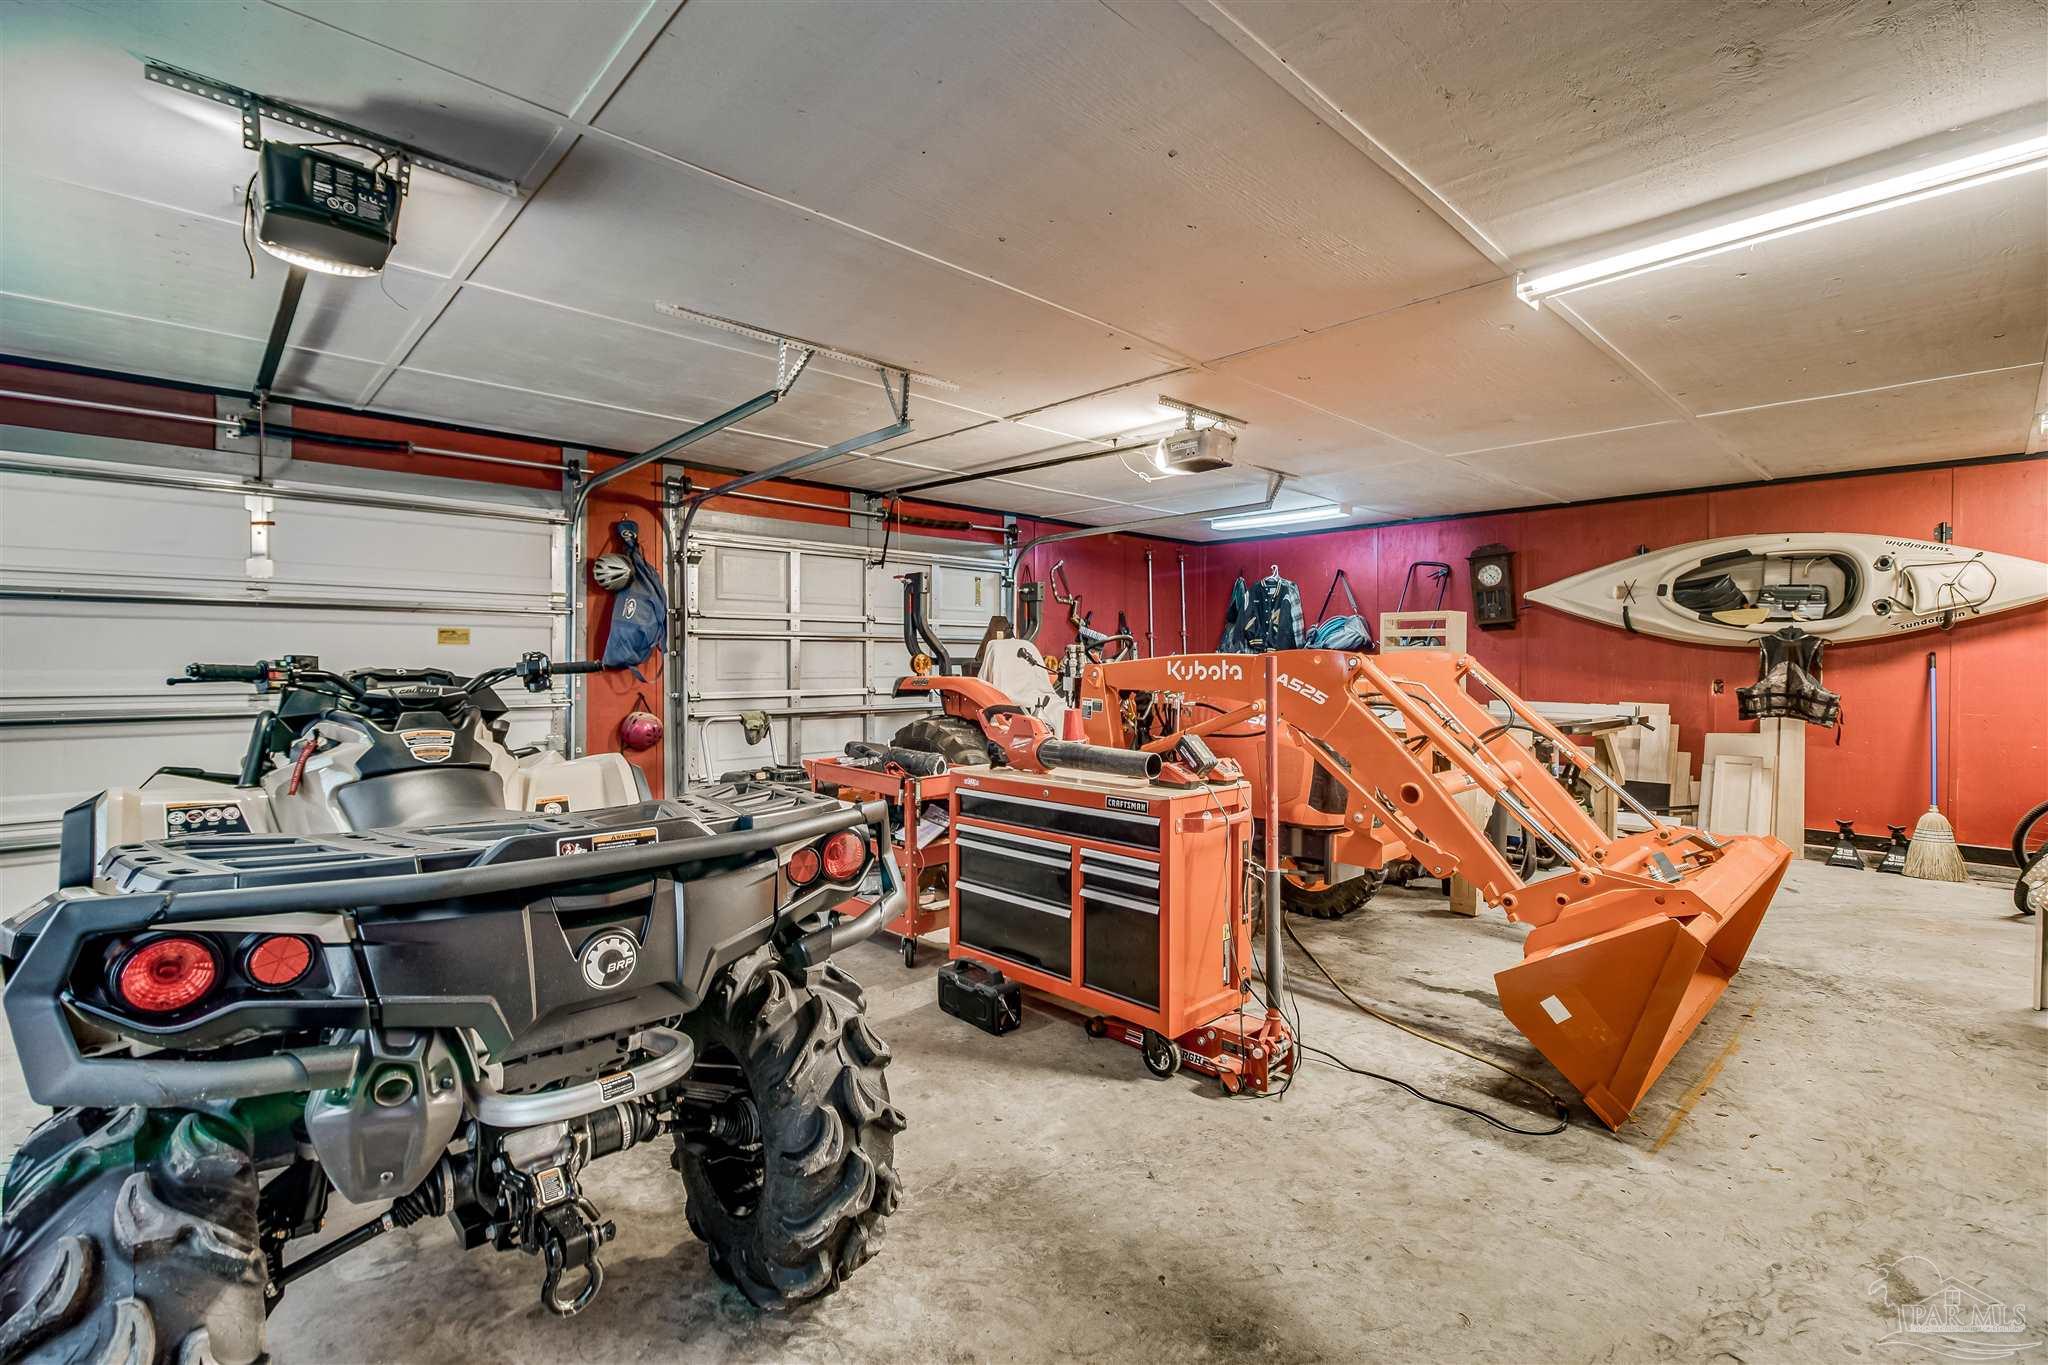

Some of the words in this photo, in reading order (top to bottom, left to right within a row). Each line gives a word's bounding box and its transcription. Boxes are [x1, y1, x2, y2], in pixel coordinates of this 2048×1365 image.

[1900, 611, 1966, 630] sundolpin
[1167, 659, 1243, 681] Kubota
[1263, 671, 1329, 705] A525
[1107, 798, 1147, 812] CRAFTSMAN
[606, 957, 634, 973] BRP
